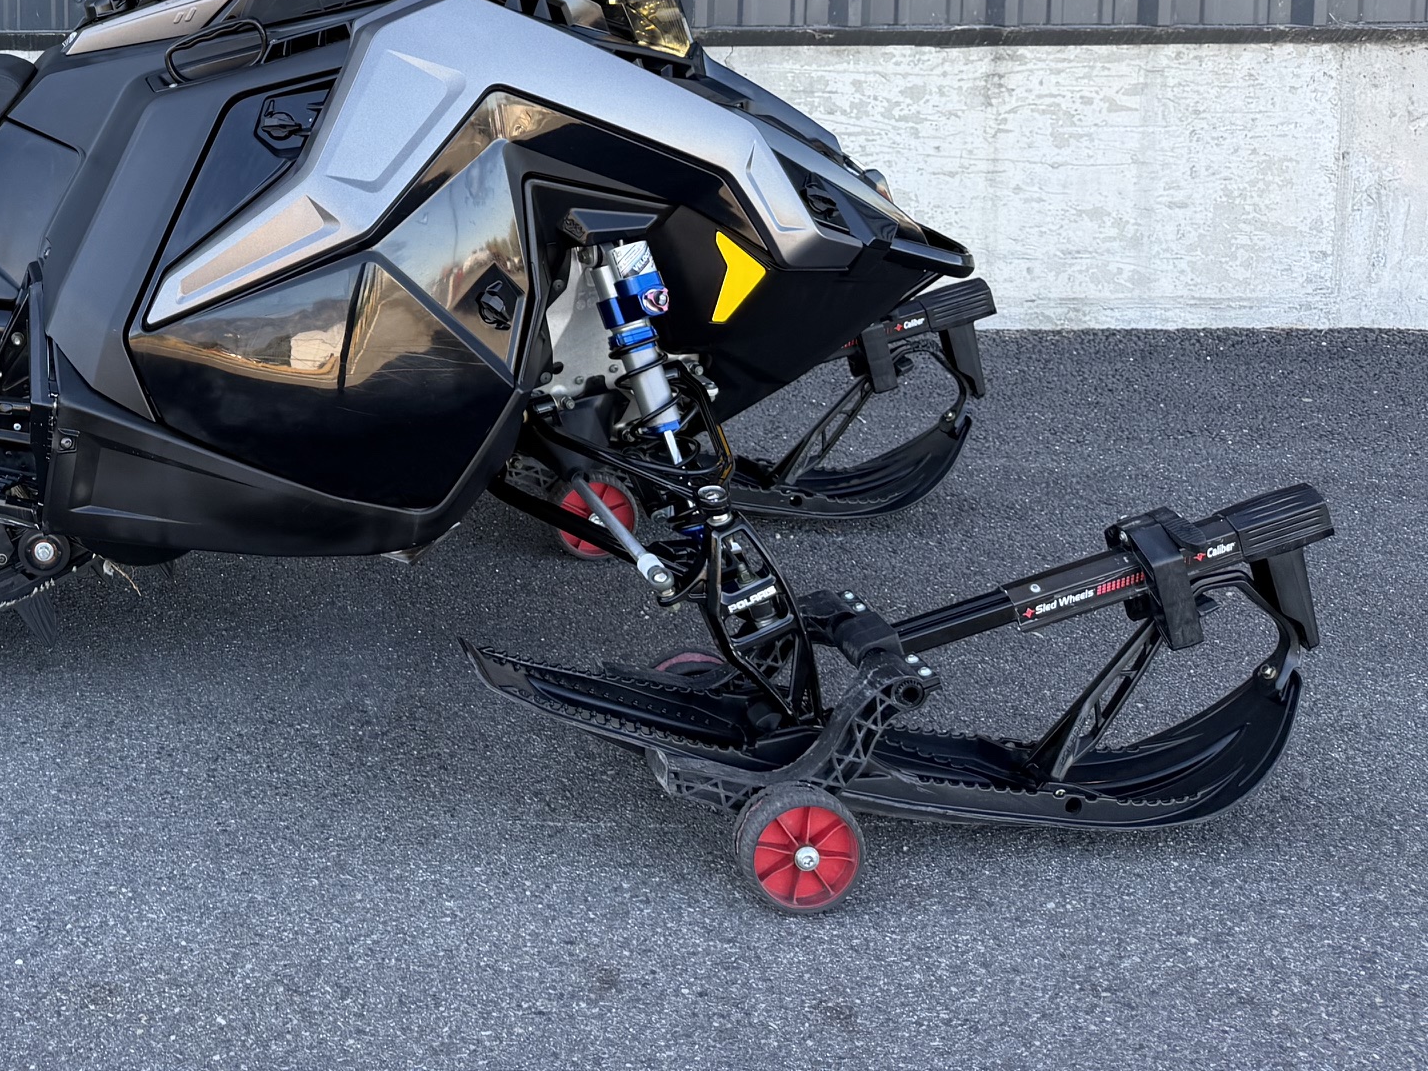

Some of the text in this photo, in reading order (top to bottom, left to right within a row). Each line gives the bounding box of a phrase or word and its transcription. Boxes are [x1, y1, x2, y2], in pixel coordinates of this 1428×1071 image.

[632, 246, 651, 272] VELOC
[1206, 542, 1235, 559] Caliber
[727, 585, 777, 613] POLARIS
[1035, 589, 1094, 615] Sled Wheels
